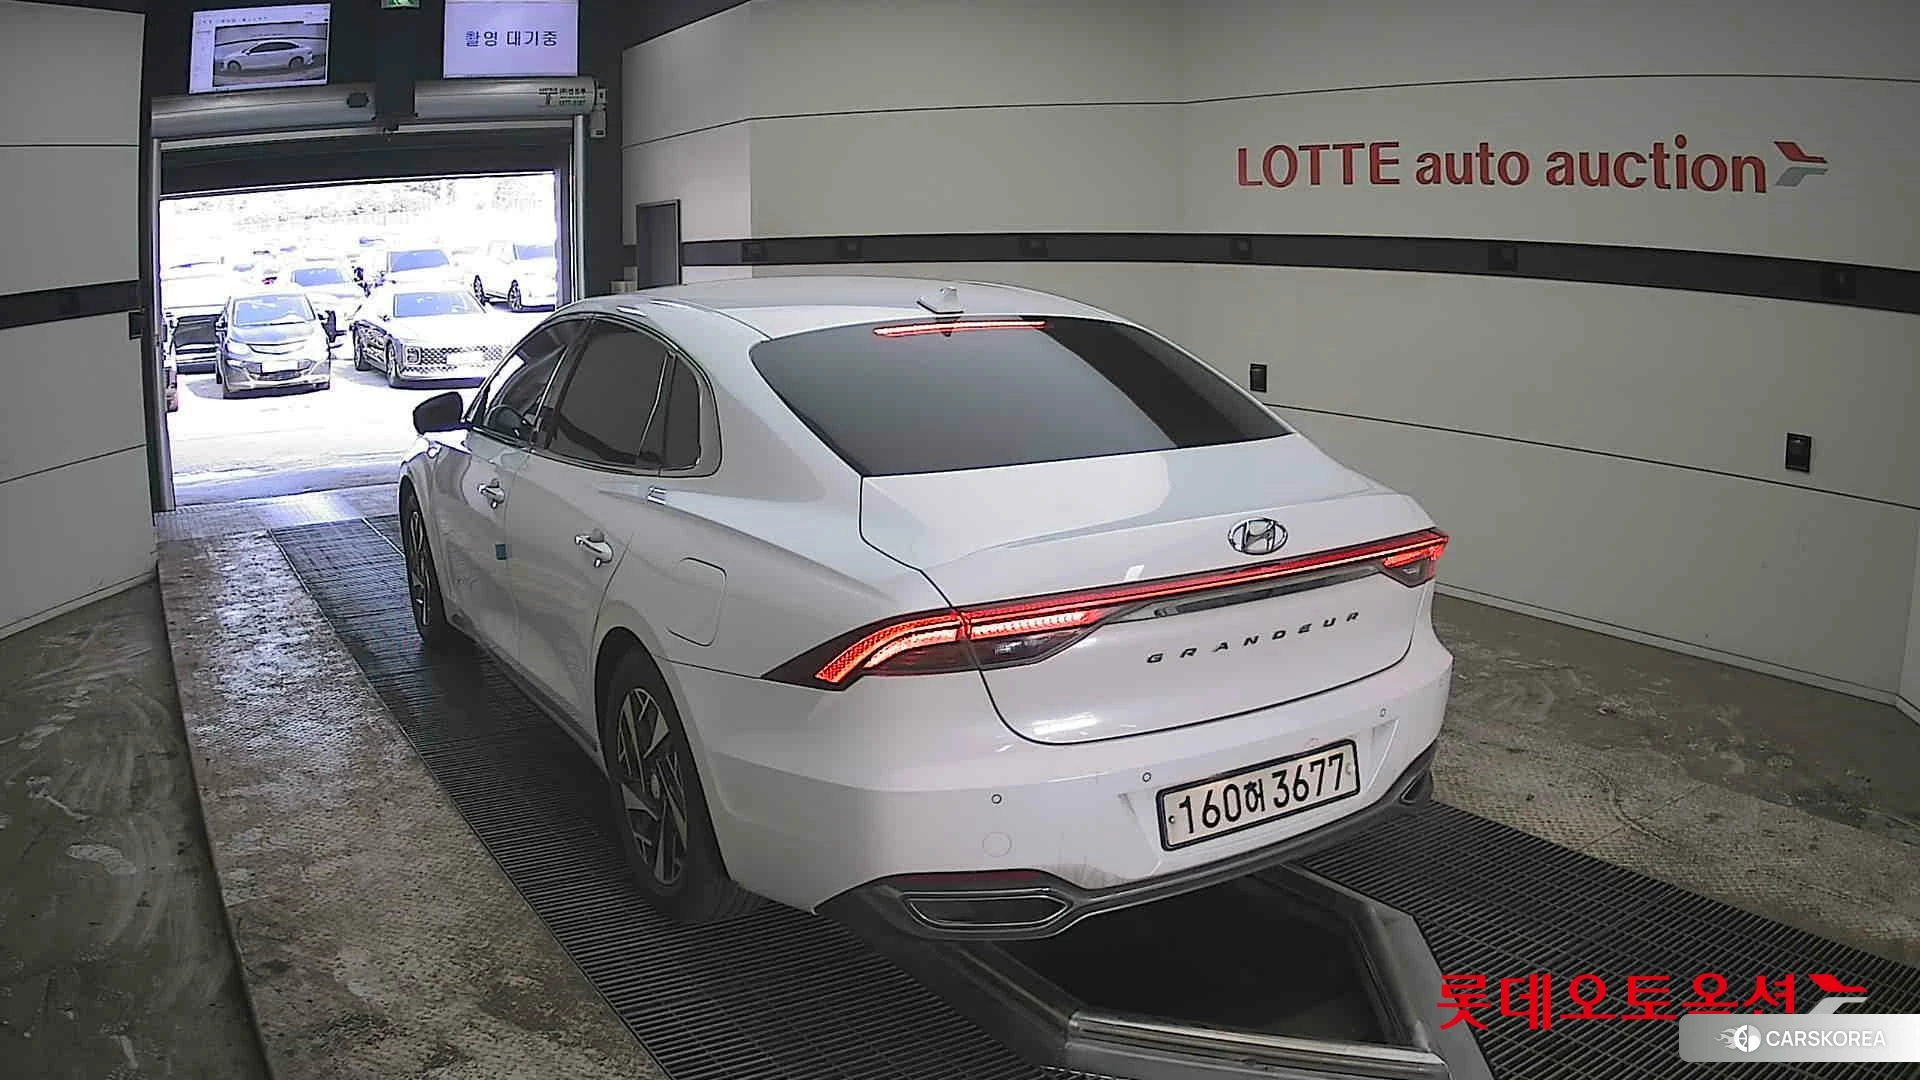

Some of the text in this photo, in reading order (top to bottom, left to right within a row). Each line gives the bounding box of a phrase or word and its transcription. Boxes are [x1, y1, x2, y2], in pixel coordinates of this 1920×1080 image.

[506, 30, 558, 47] 대기중
[1237, 134, 1767, 194] LOTTE auto auction
[1146, 611, 1359, 663] GRANDEUR
